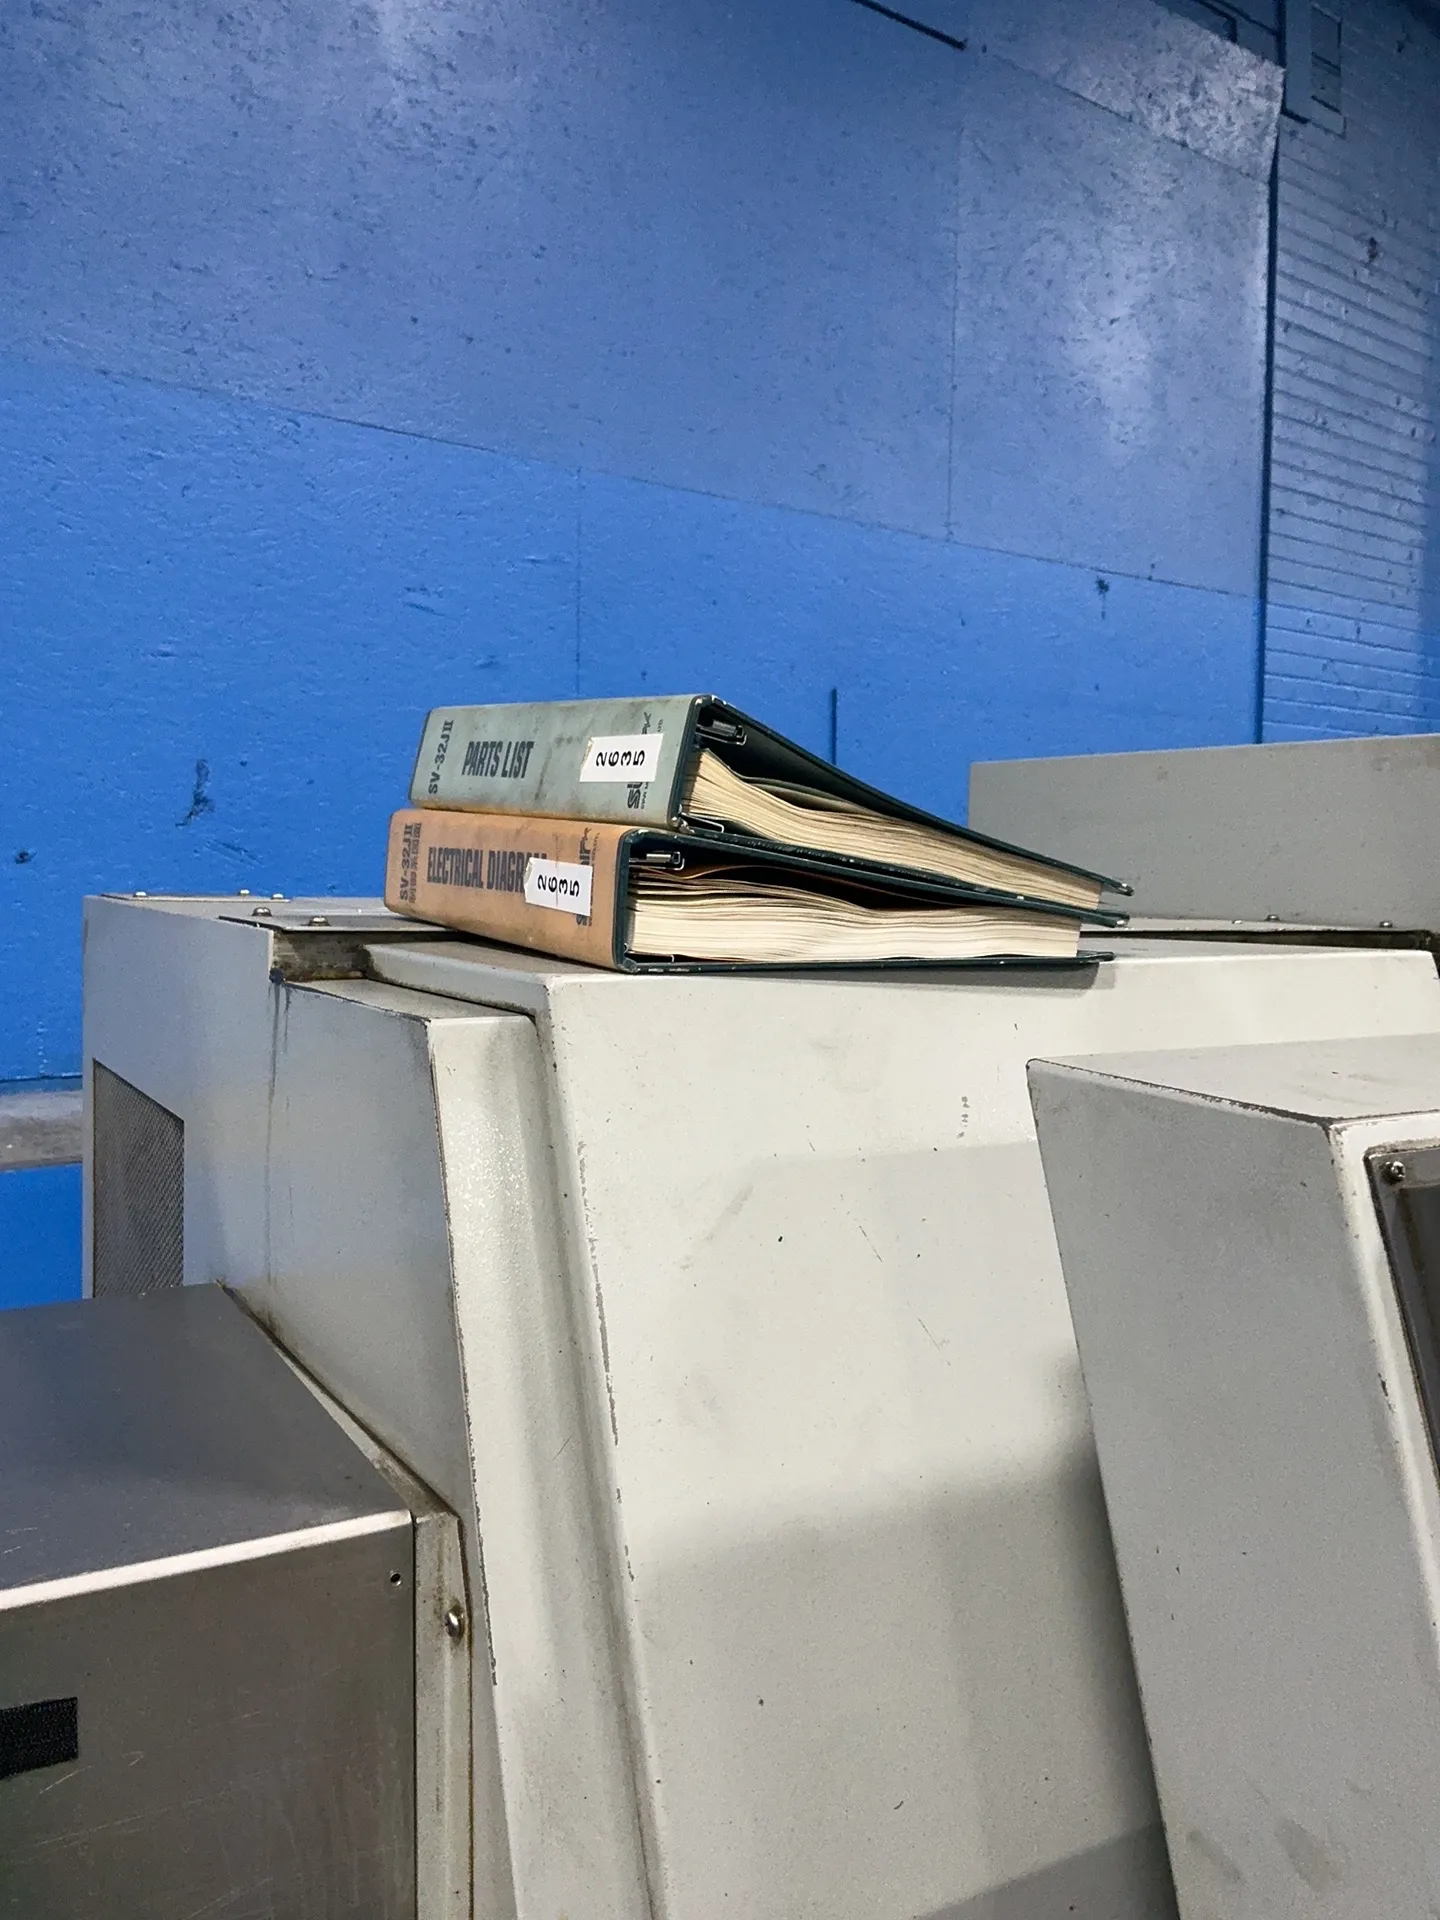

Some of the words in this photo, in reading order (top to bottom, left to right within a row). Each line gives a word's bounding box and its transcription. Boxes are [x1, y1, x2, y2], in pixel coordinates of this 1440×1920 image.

[461, 740, 502, 778] PARTS
[500, 740, 535, 779] LIST
[595, 749, 645, 768] 2635
[426, 846, 484, 889] ELECTRICAL
[537, 873, 580, 898] 2635
